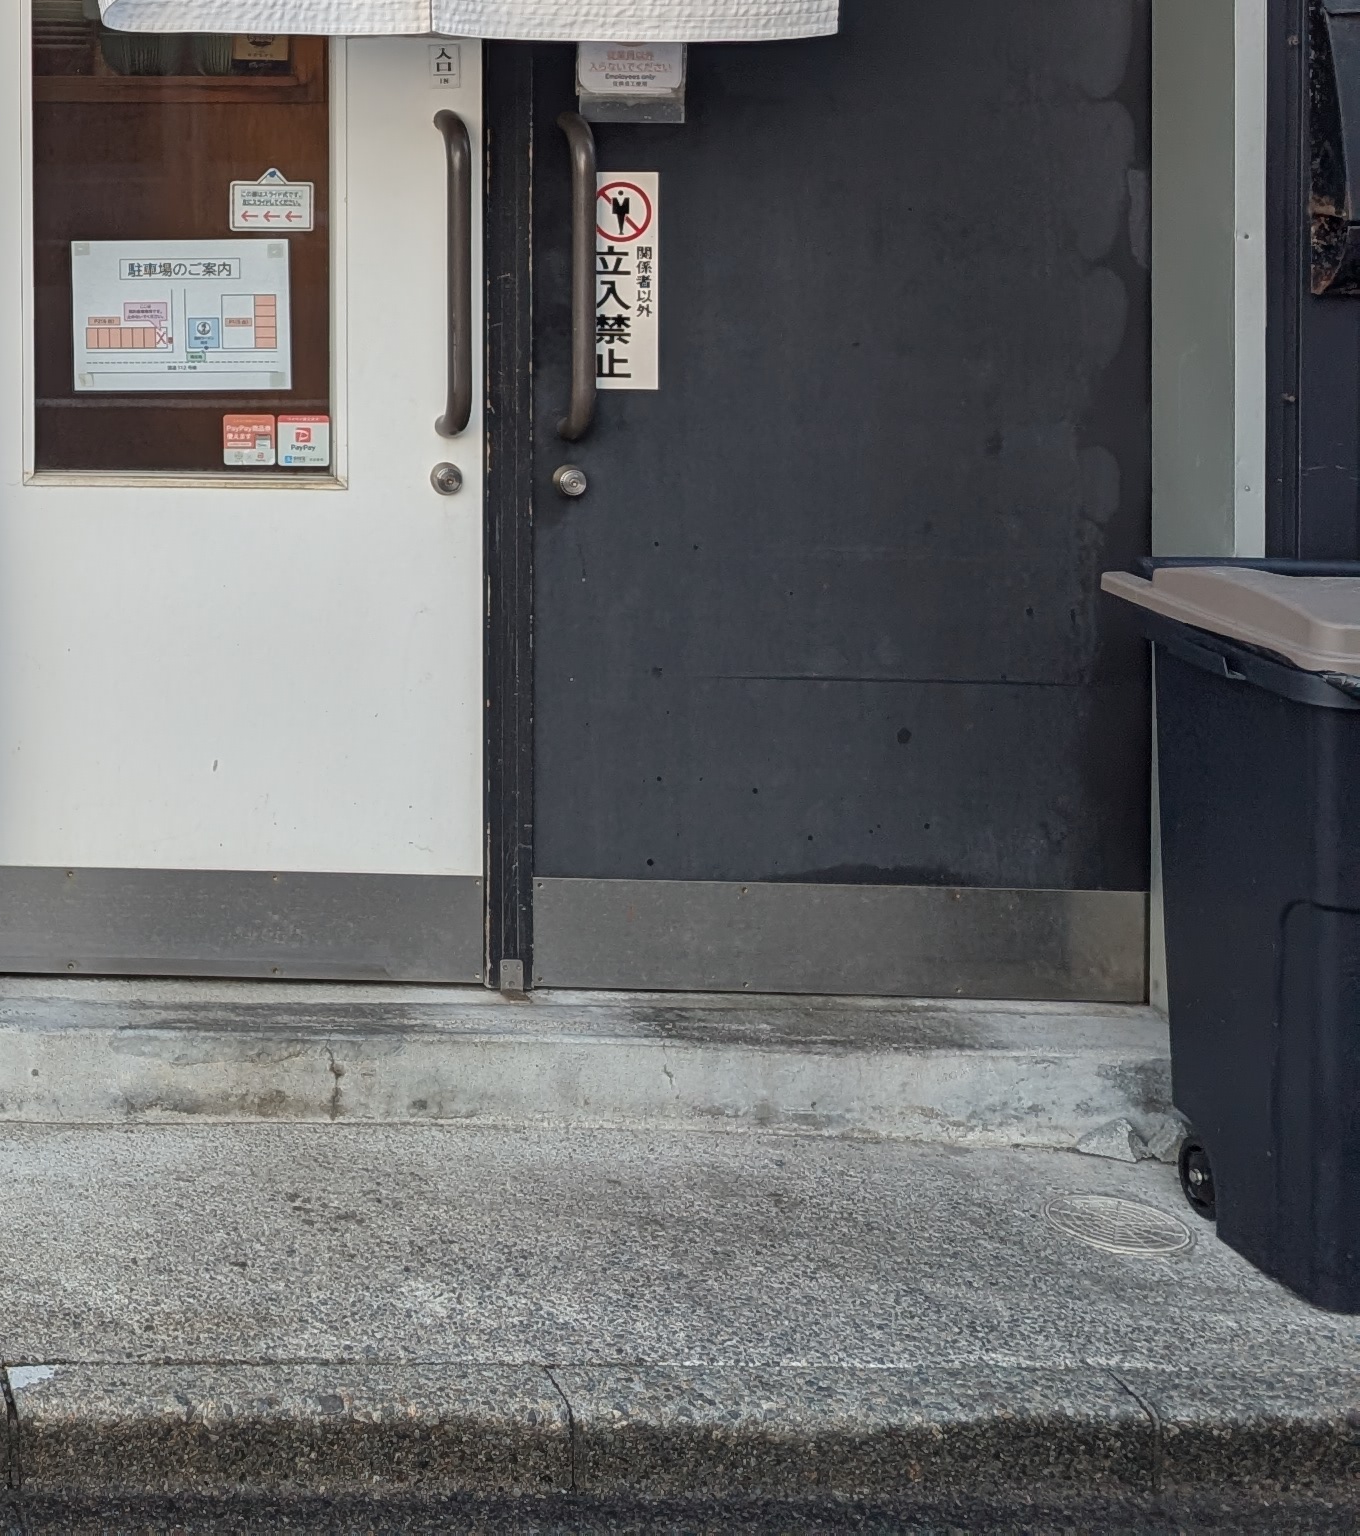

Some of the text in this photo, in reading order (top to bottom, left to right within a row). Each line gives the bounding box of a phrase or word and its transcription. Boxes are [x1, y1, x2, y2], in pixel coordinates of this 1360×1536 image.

[127, 262, 232, 278] 駐車場のご案内
[636, 246, 653, 317] 関係者以外
[596, 246, 631, 379] 立入禁止
[290, 444, 317, 452] PayPay
